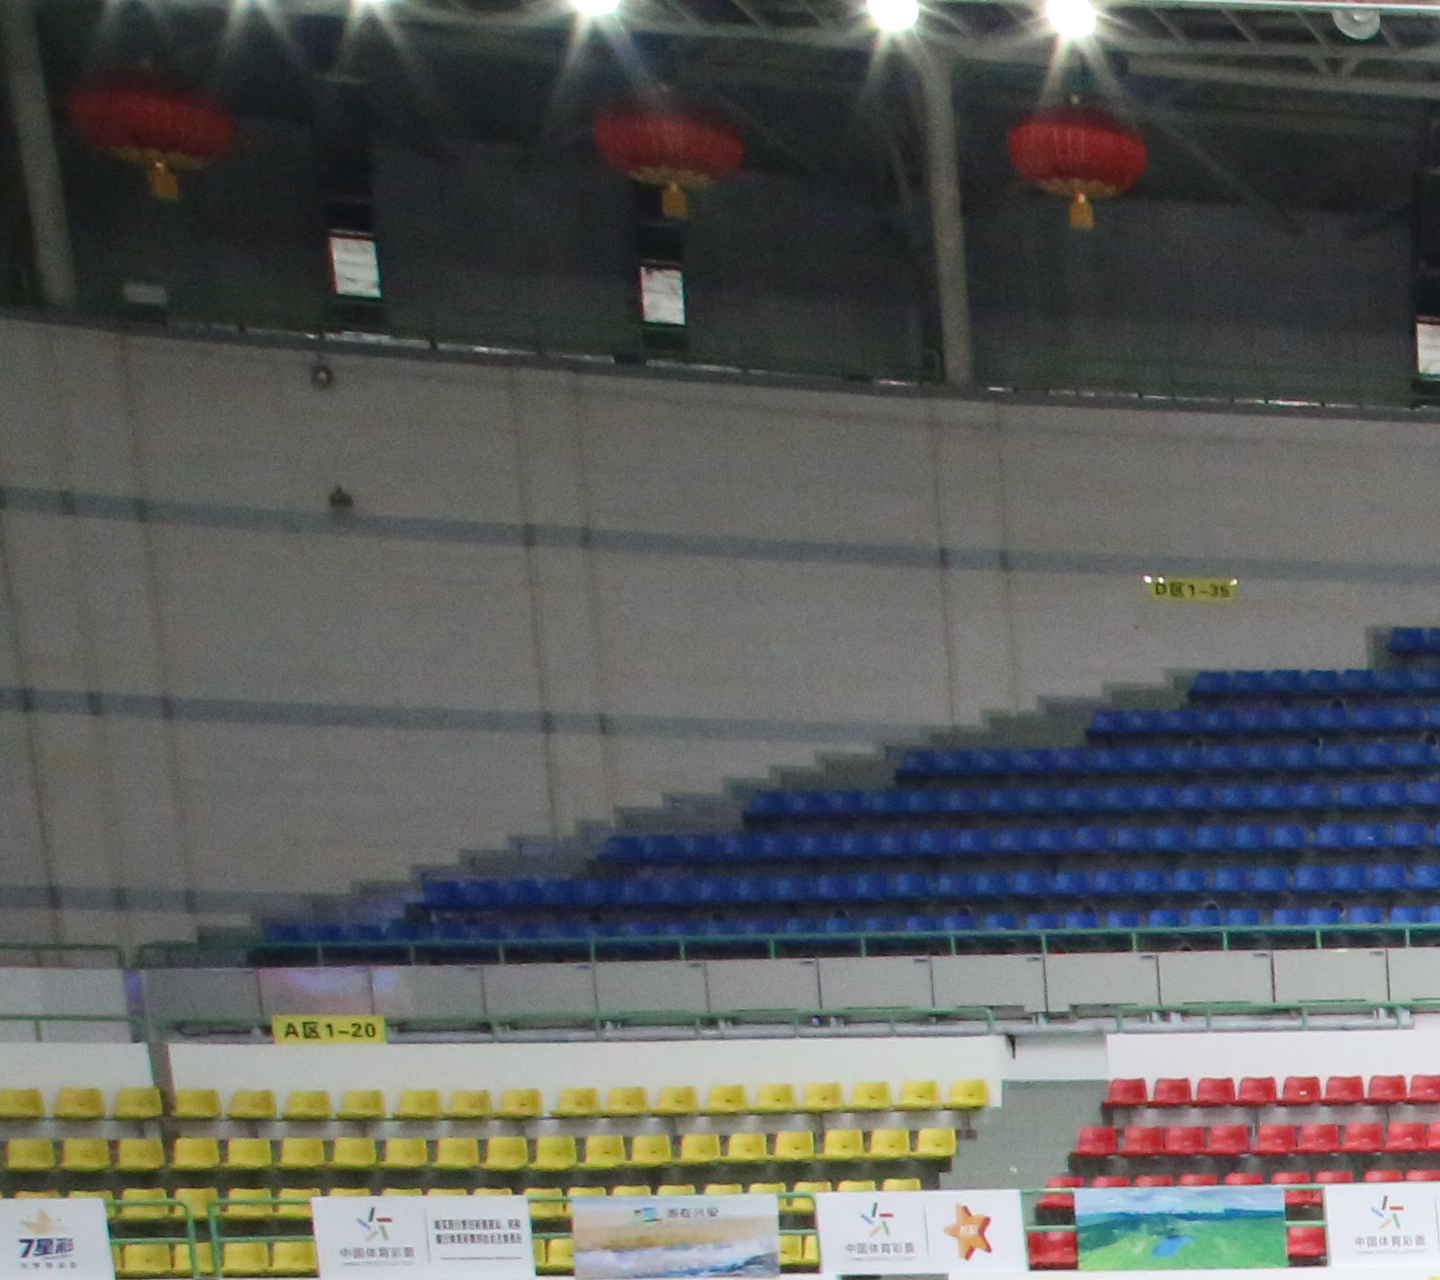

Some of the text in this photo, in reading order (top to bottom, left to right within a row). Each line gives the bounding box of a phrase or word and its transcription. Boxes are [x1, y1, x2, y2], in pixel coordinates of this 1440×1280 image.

[284, 1020, 377, 1040] A区1-20
[1354, 1234, 1426, 1247] 中国体育彩票
[845, 1242, 916, 1255] 中国体育彩票
